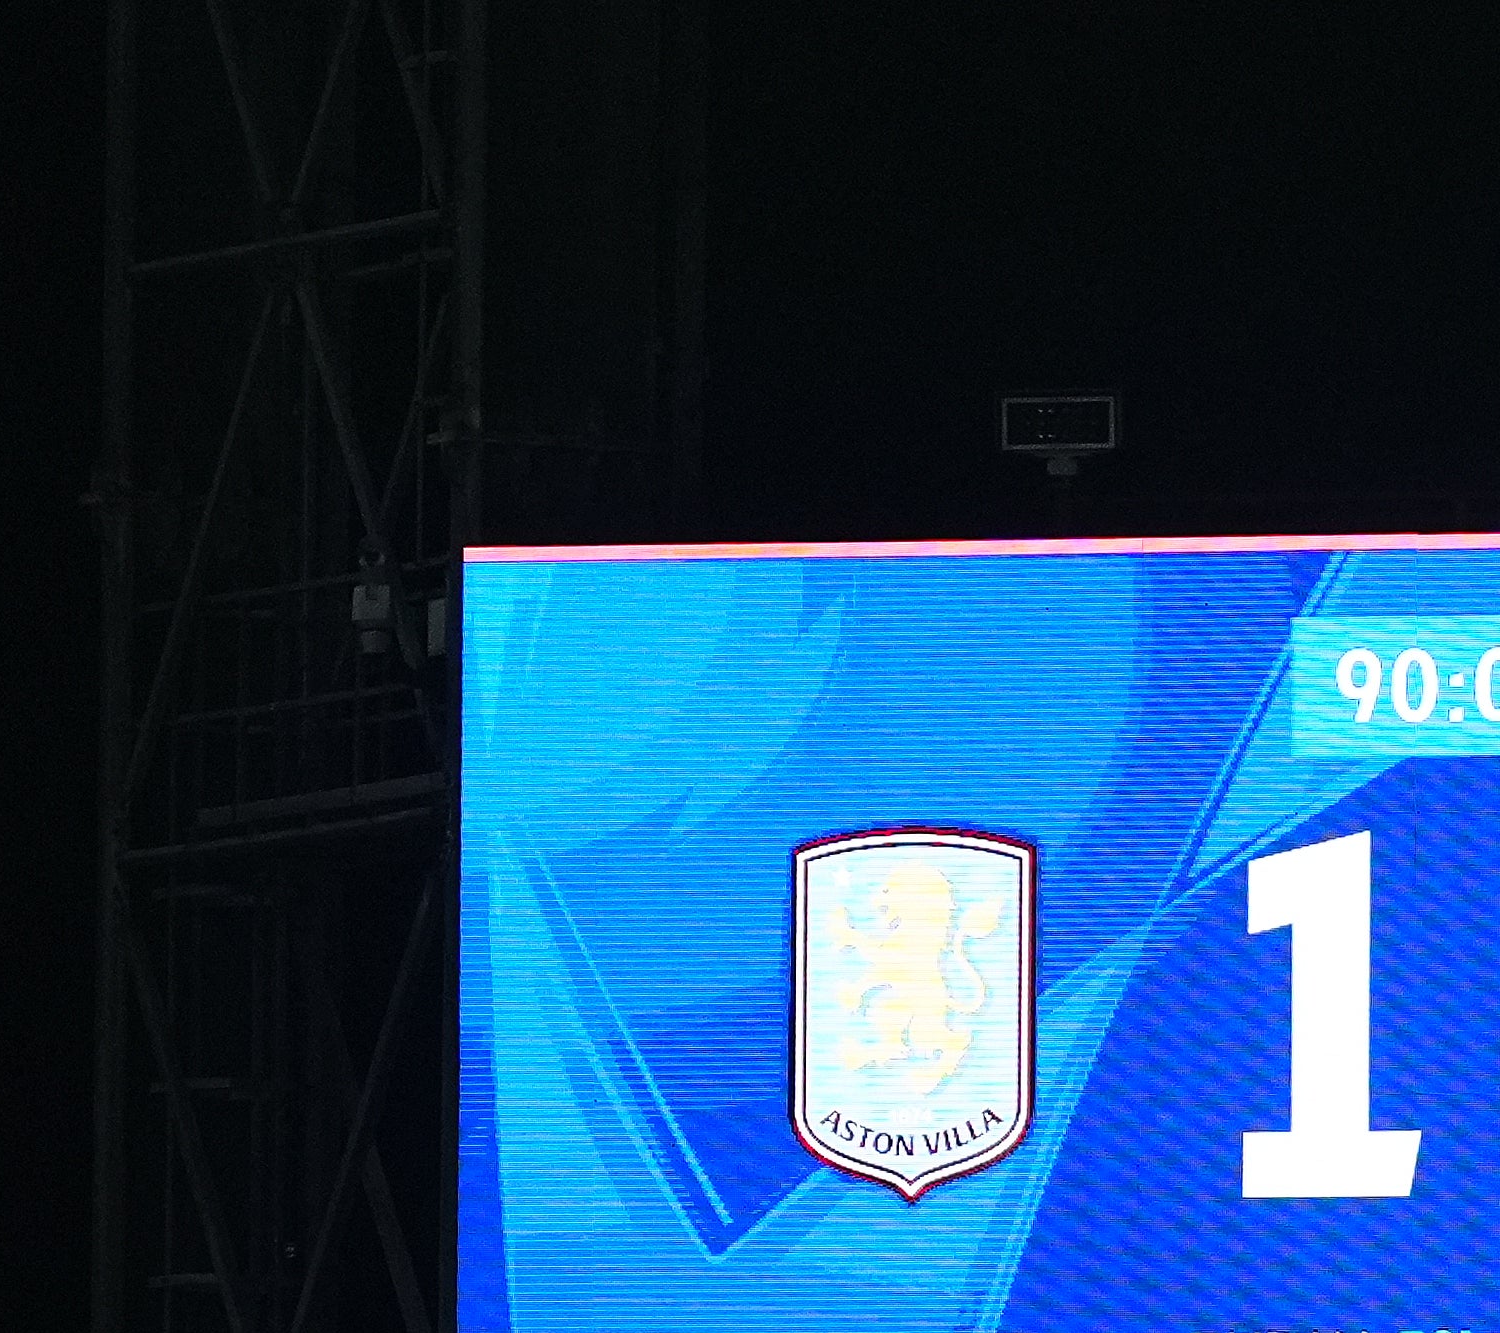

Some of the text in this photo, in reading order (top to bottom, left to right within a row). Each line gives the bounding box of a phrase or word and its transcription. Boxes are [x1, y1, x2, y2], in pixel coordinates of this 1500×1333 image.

[1243, 831, 1422, 1199] 1
[819, 1106, 1005, 1157] ASTON VILLA
